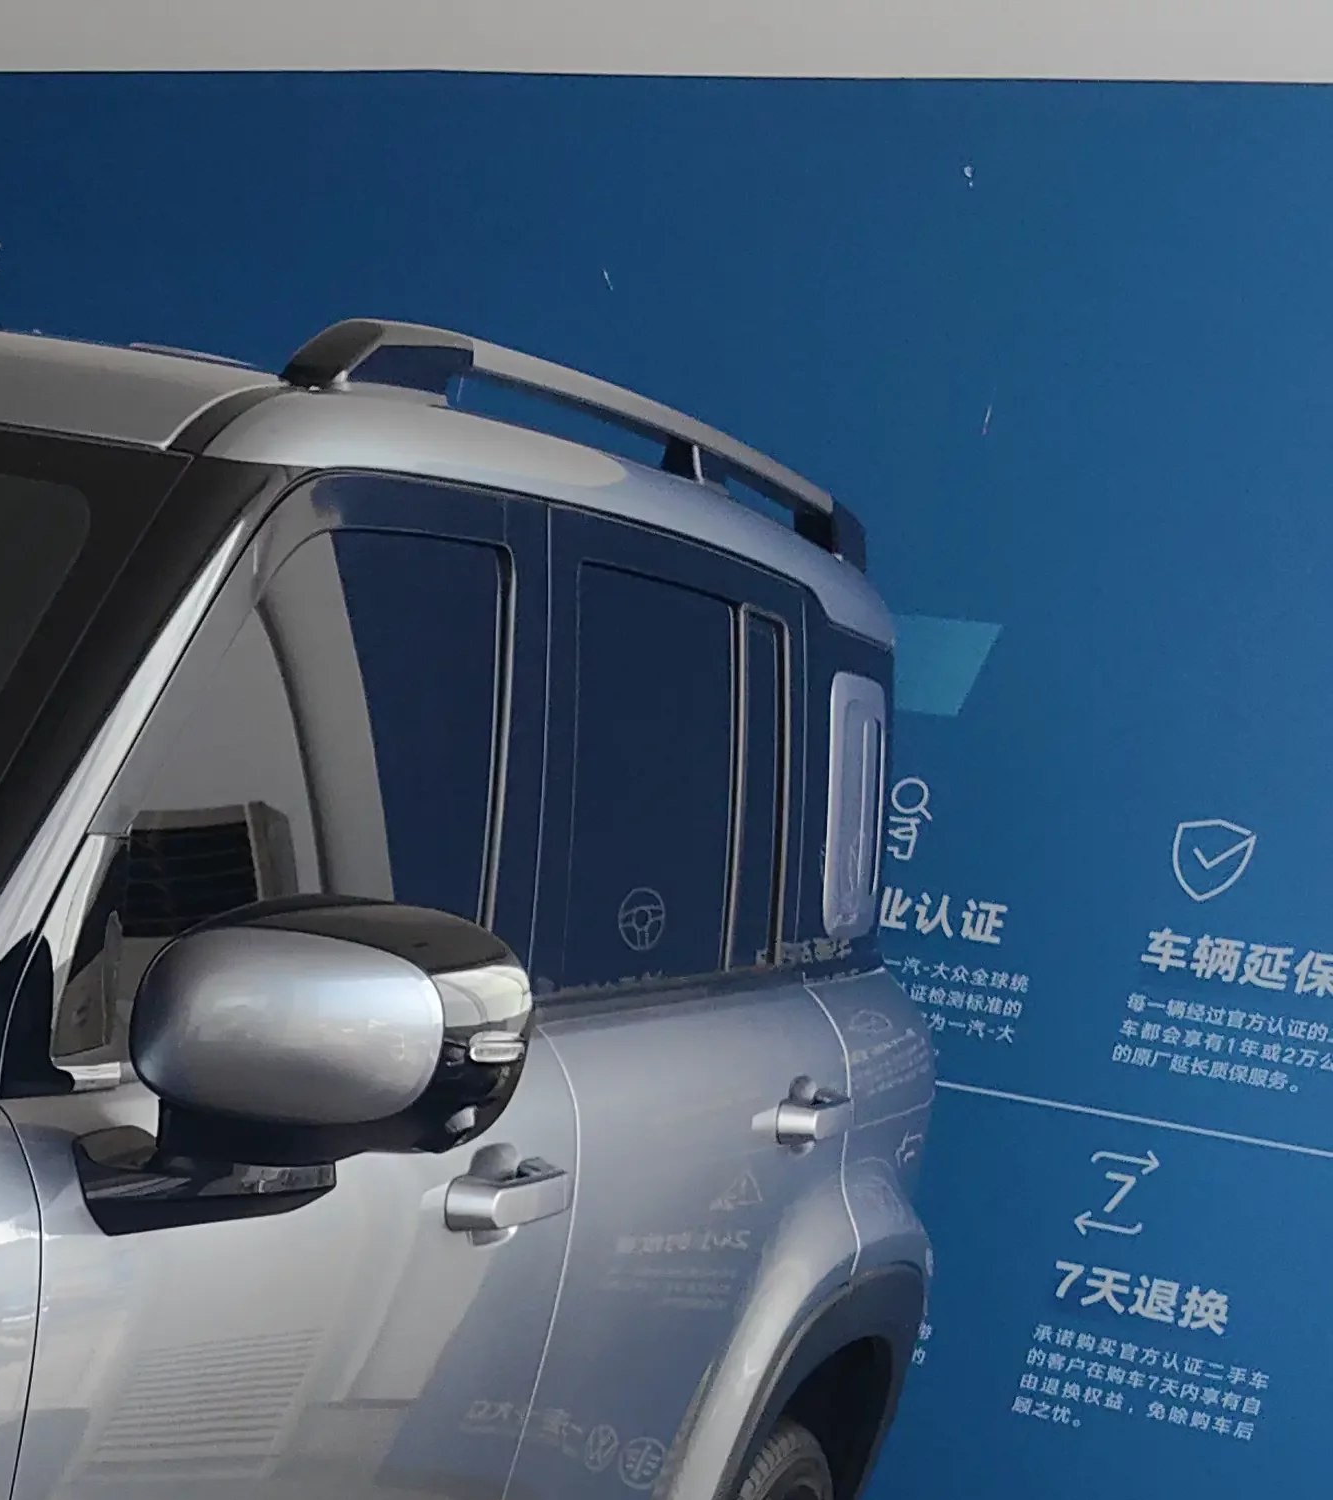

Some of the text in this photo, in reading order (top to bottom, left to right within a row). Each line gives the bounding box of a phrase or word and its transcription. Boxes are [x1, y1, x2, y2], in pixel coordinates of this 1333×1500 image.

[1141, 926, 1333, 998] 车辆延保
[899, 982, 1023, 1019] 证检测标准的
[921, 1012, 1015, 1044] 为一汽-大
[1126, 992, 1333, 1044] 每一辆经过官方认证的
[1054, 1260, 1231, 1336] 7天退换
[1025, 1347, 1262, 1417] 的客户在购车7天内享有自
[1031, 1323, 1271, 1391] 承诺购买官方认证二手车
[1011, 1396, 1082, 1428] 顾之忧。
